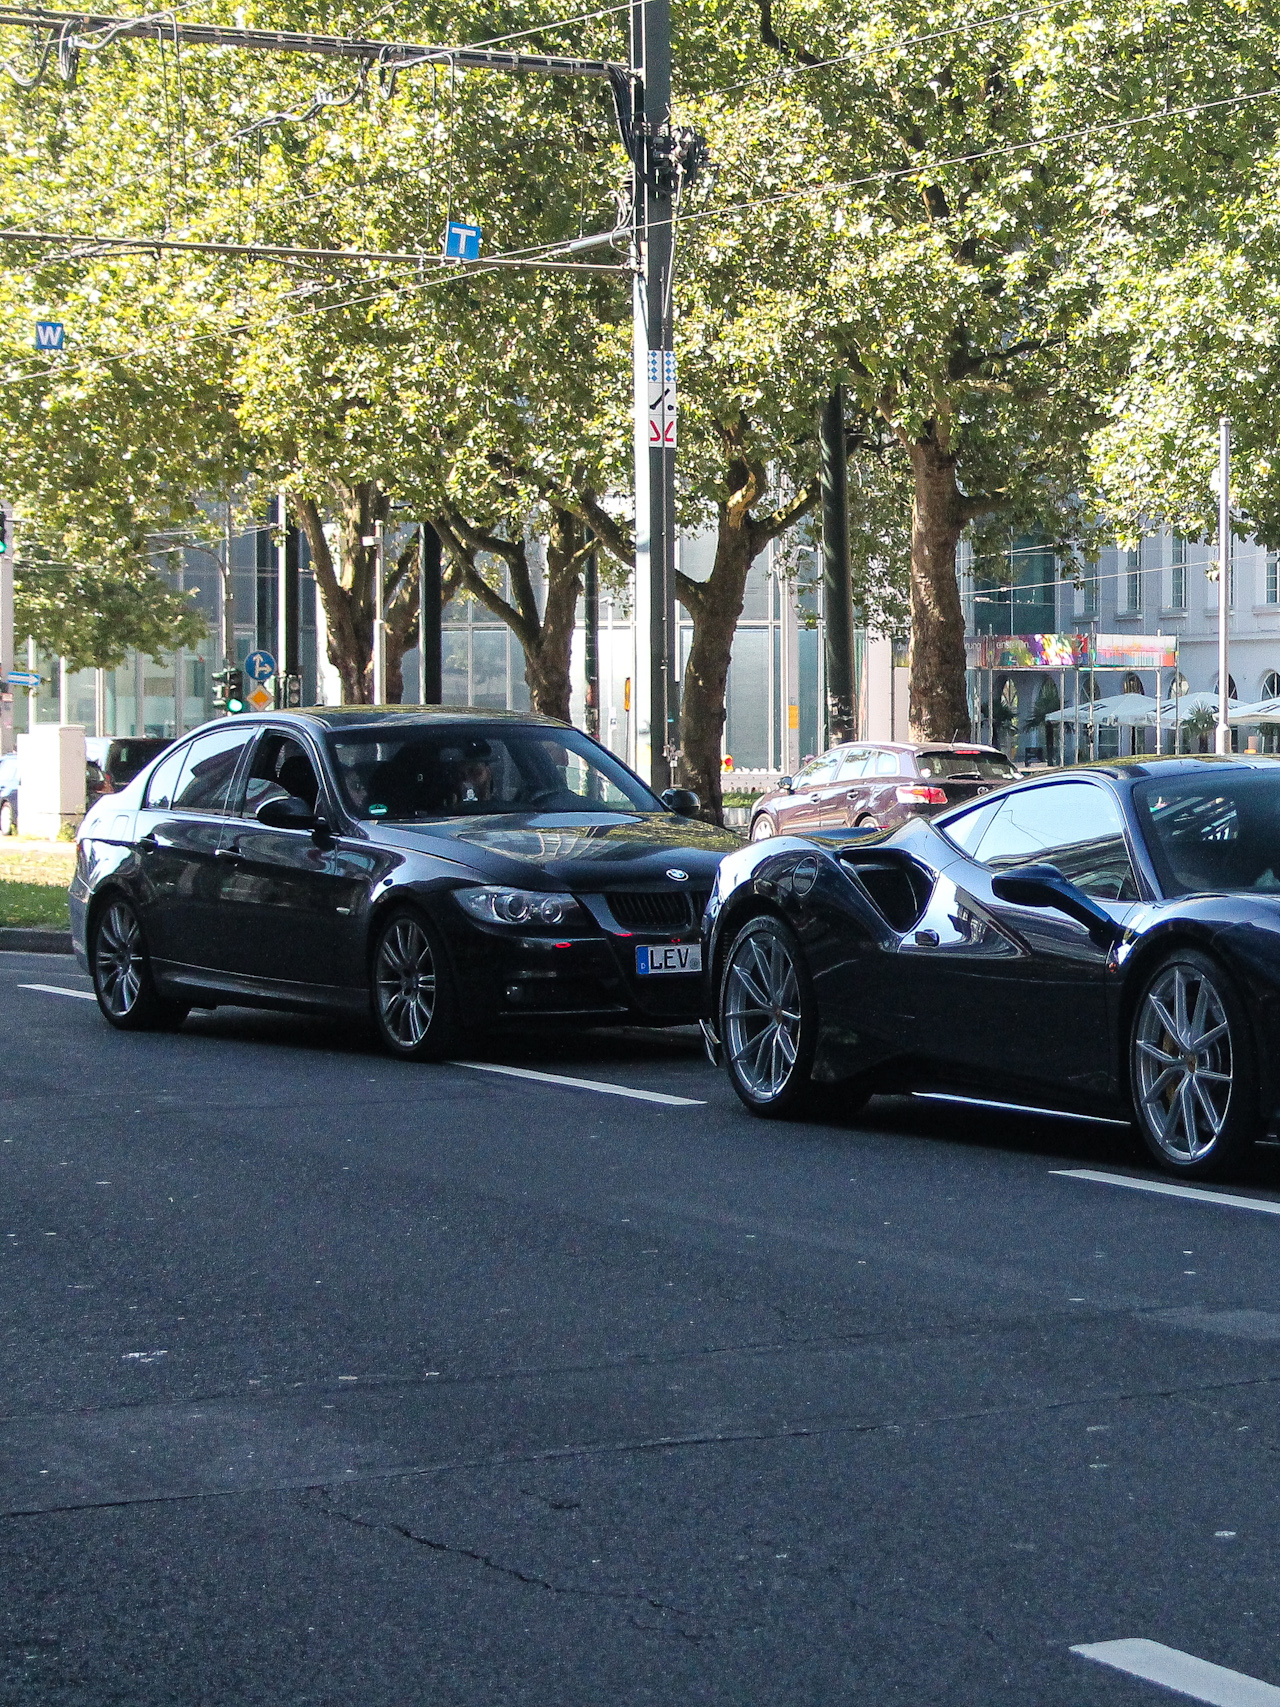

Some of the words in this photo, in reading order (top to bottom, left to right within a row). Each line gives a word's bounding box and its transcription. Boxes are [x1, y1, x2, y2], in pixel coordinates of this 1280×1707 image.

[451, 227, 477, 254] T
[37, 325, 62, 346] W
[650, 948, 689, 970] LEV
